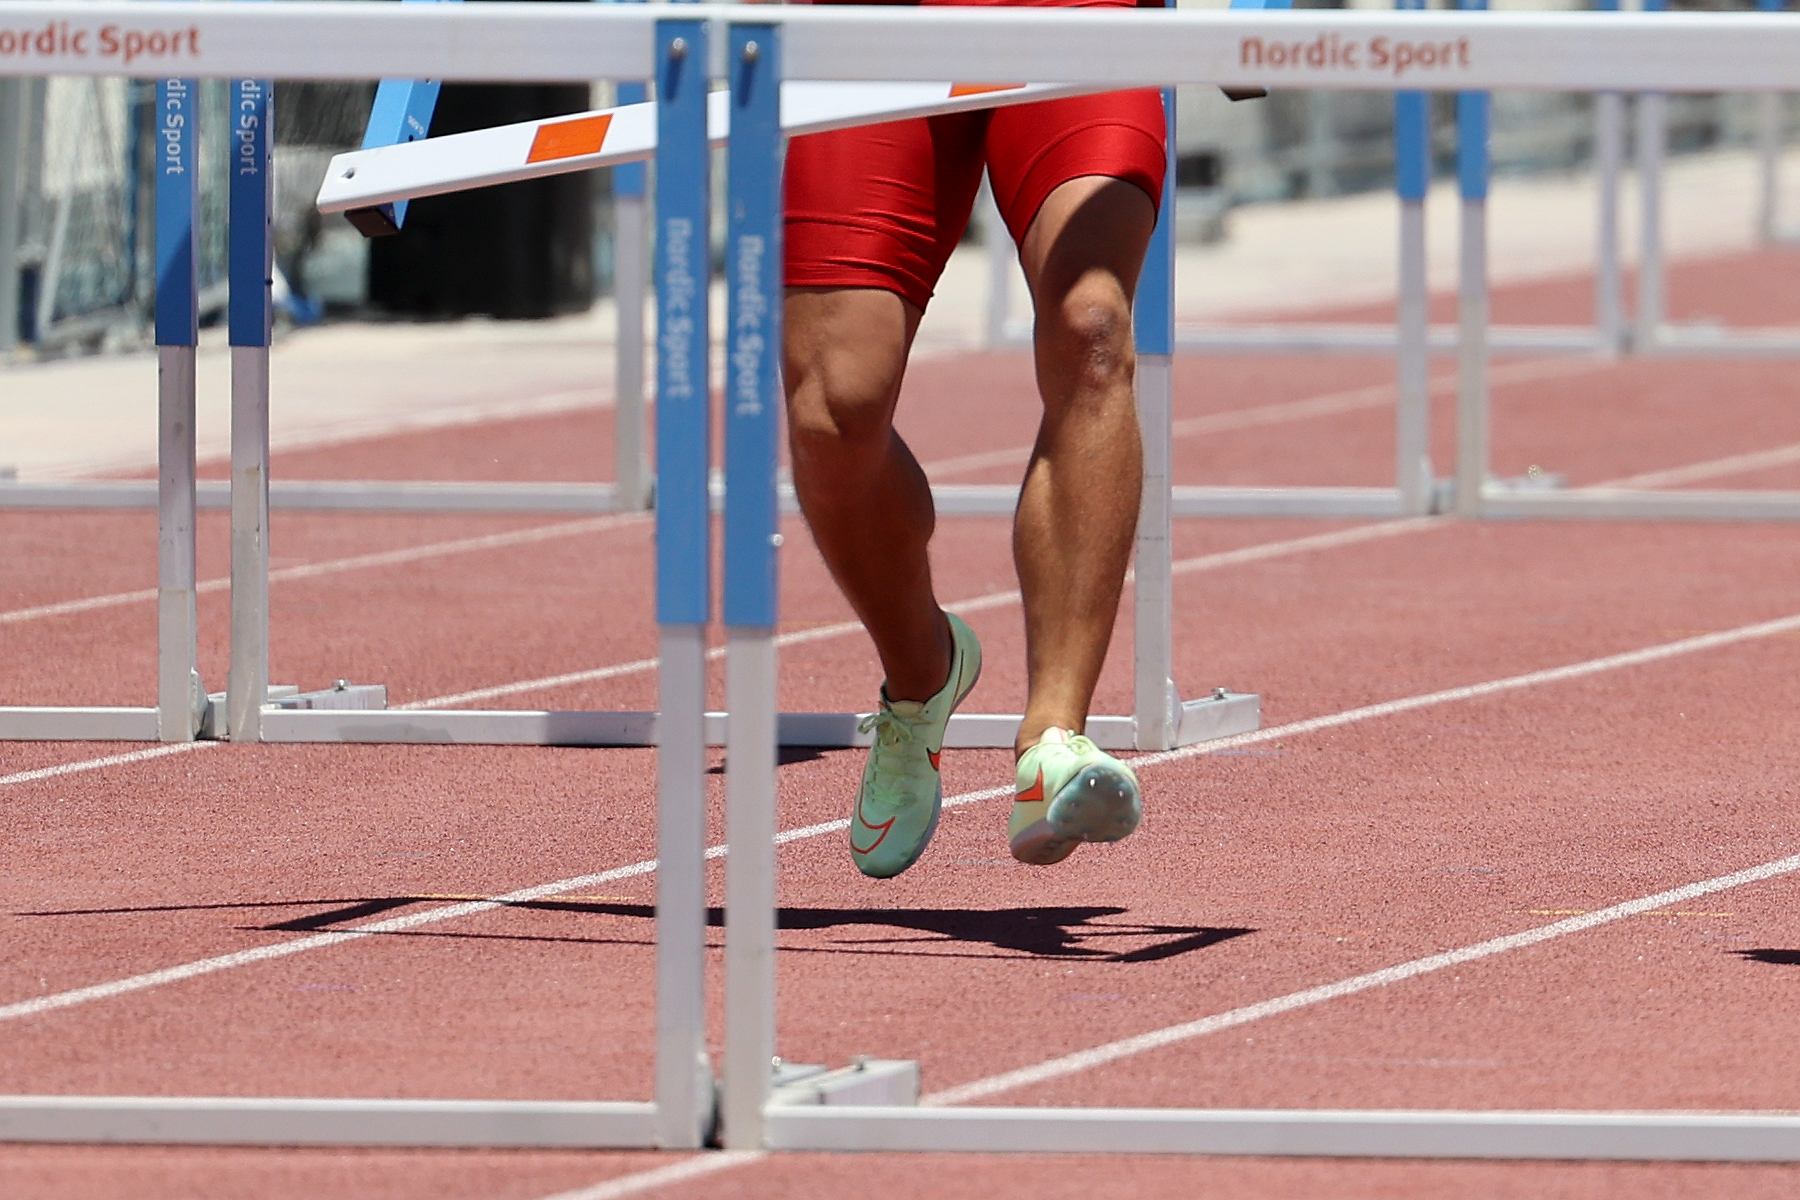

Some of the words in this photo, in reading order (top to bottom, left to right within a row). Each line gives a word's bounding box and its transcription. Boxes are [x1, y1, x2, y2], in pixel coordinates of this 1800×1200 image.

[0, 21, 88, 56] ordic
[98, 23, 201, 65] Sport
[1366, 34, 1470, 77] Sport
[166, 79, 187, 110] dic
[240, 79, 261, 111] dic
[162, 114, 185, 174] Sport
[235, 114, 259, 175] Sport
